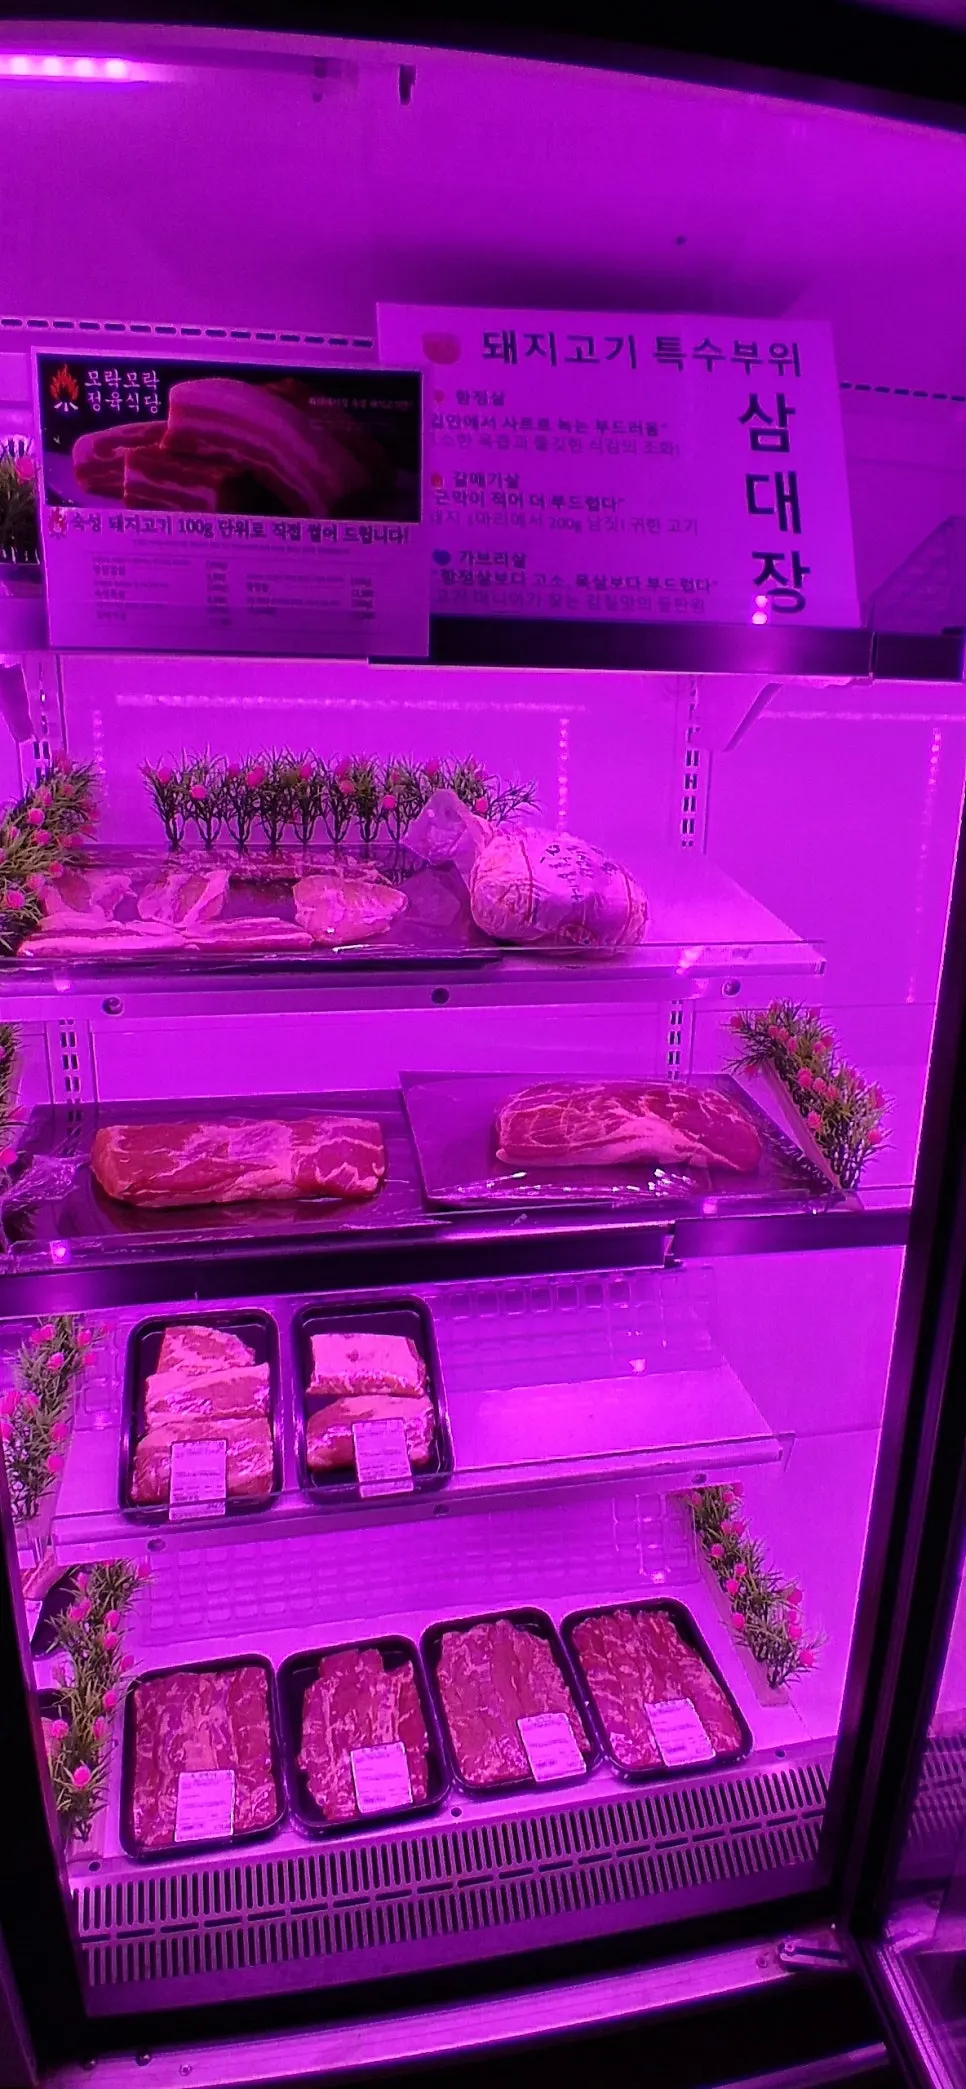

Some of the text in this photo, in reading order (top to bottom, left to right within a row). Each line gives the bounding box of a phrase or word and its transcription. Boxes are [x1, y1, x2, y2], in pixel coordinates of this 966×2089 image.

[481, 329, 803, 377] 돼지고기 특수부위
[85, 368, 160, 391] 모락모락
[84, 392, 161, 416] 정육식당
[453, 471, 520, 489] 갈매기살
[528, 494, 546, 509] 더
[109, 514, 172, 536] 돼지고기
[178, 518, 214, 539] 100g
[218, 519, 267, 541] 단위로
[272, 521, 301, 543] 직접
[342, 524, 410, 546] 드립니다!
[667, 518, 699, 535] 고기
[460, 550, 526, 569] 가브리살
